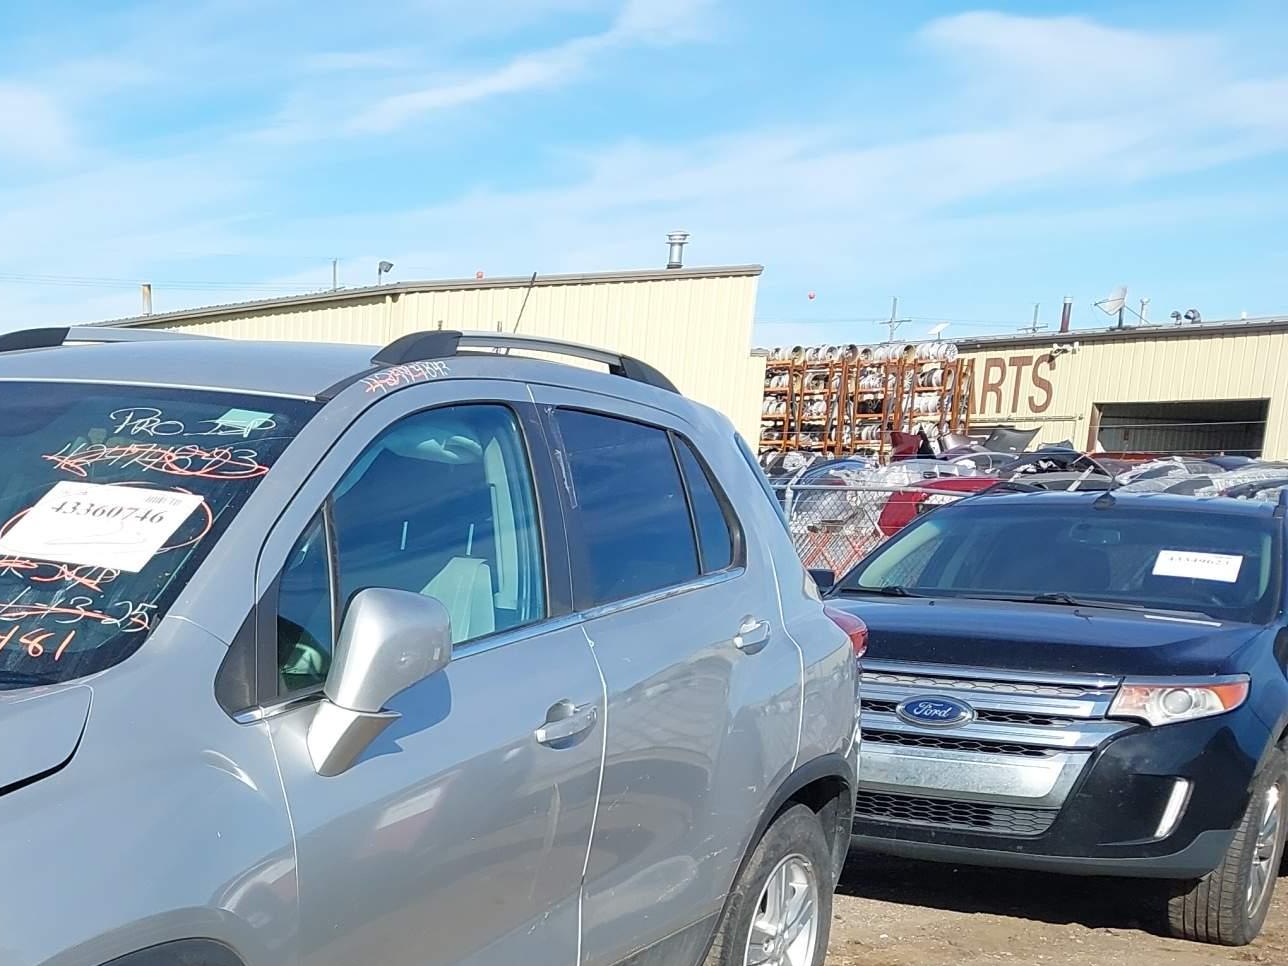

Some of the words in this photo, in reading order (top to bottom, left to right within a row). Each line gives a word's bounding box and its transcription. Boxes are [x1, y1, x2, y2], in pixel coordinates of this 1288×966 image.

[946, 354, 1057, 414] ARTS
[51, 499, 166, 525] 43360746
[913, 701, 953, 718] Ford
